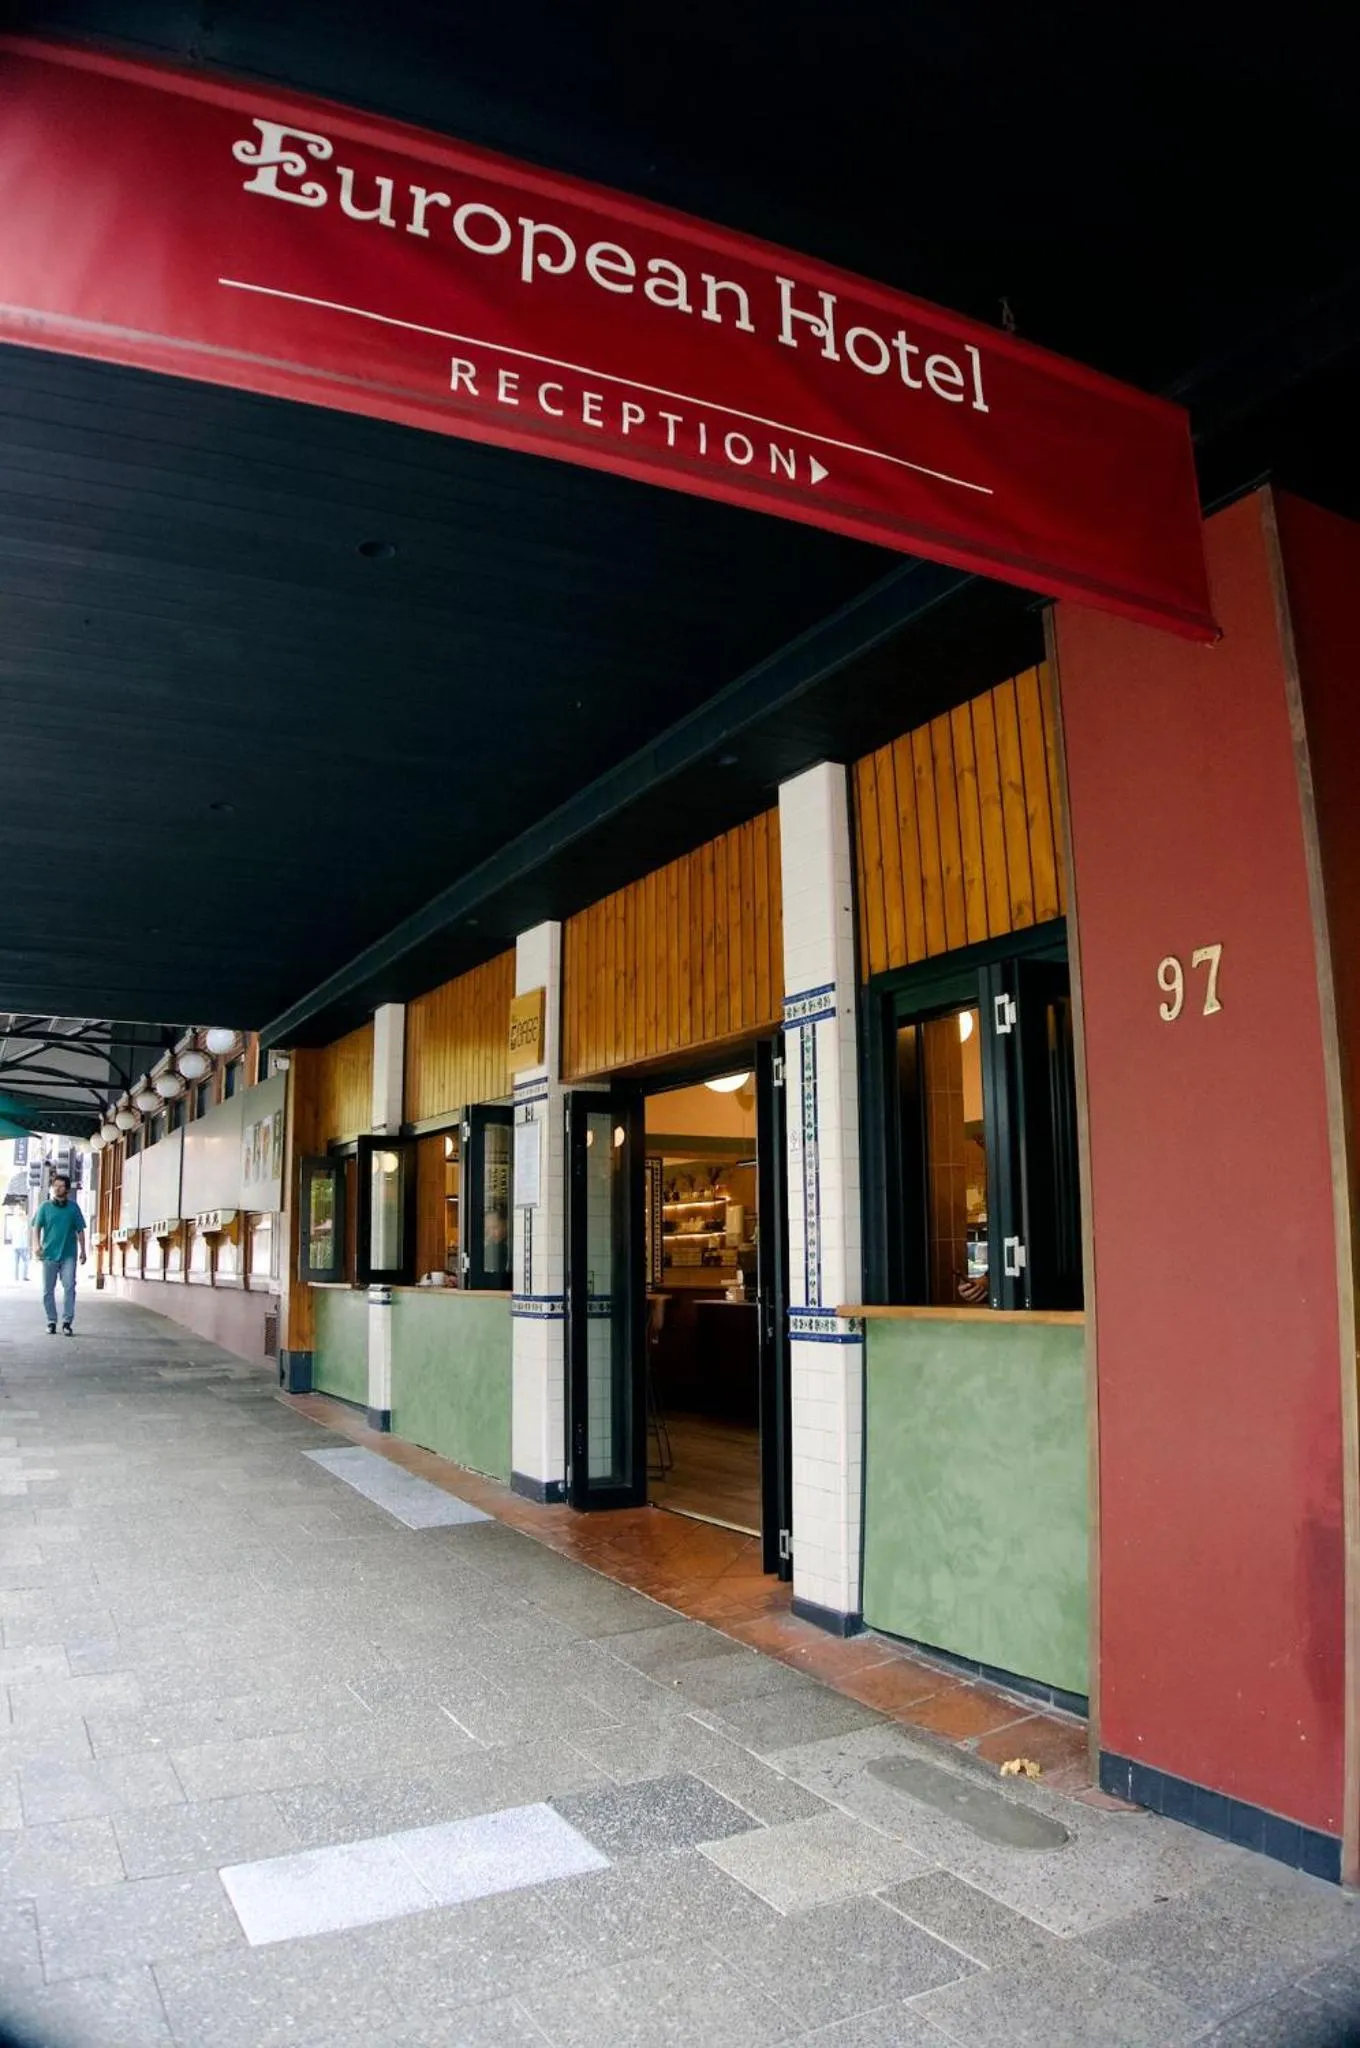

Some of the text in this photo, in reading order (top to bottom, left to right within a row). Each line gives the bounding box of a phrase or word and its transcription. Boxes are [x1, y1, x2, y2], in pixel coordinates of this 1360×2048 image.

[232, 118, 991, 413] European Hotel
[450, 357, 797, 481] RECEPTION
[1157, 944, 1222, 1021] 97
